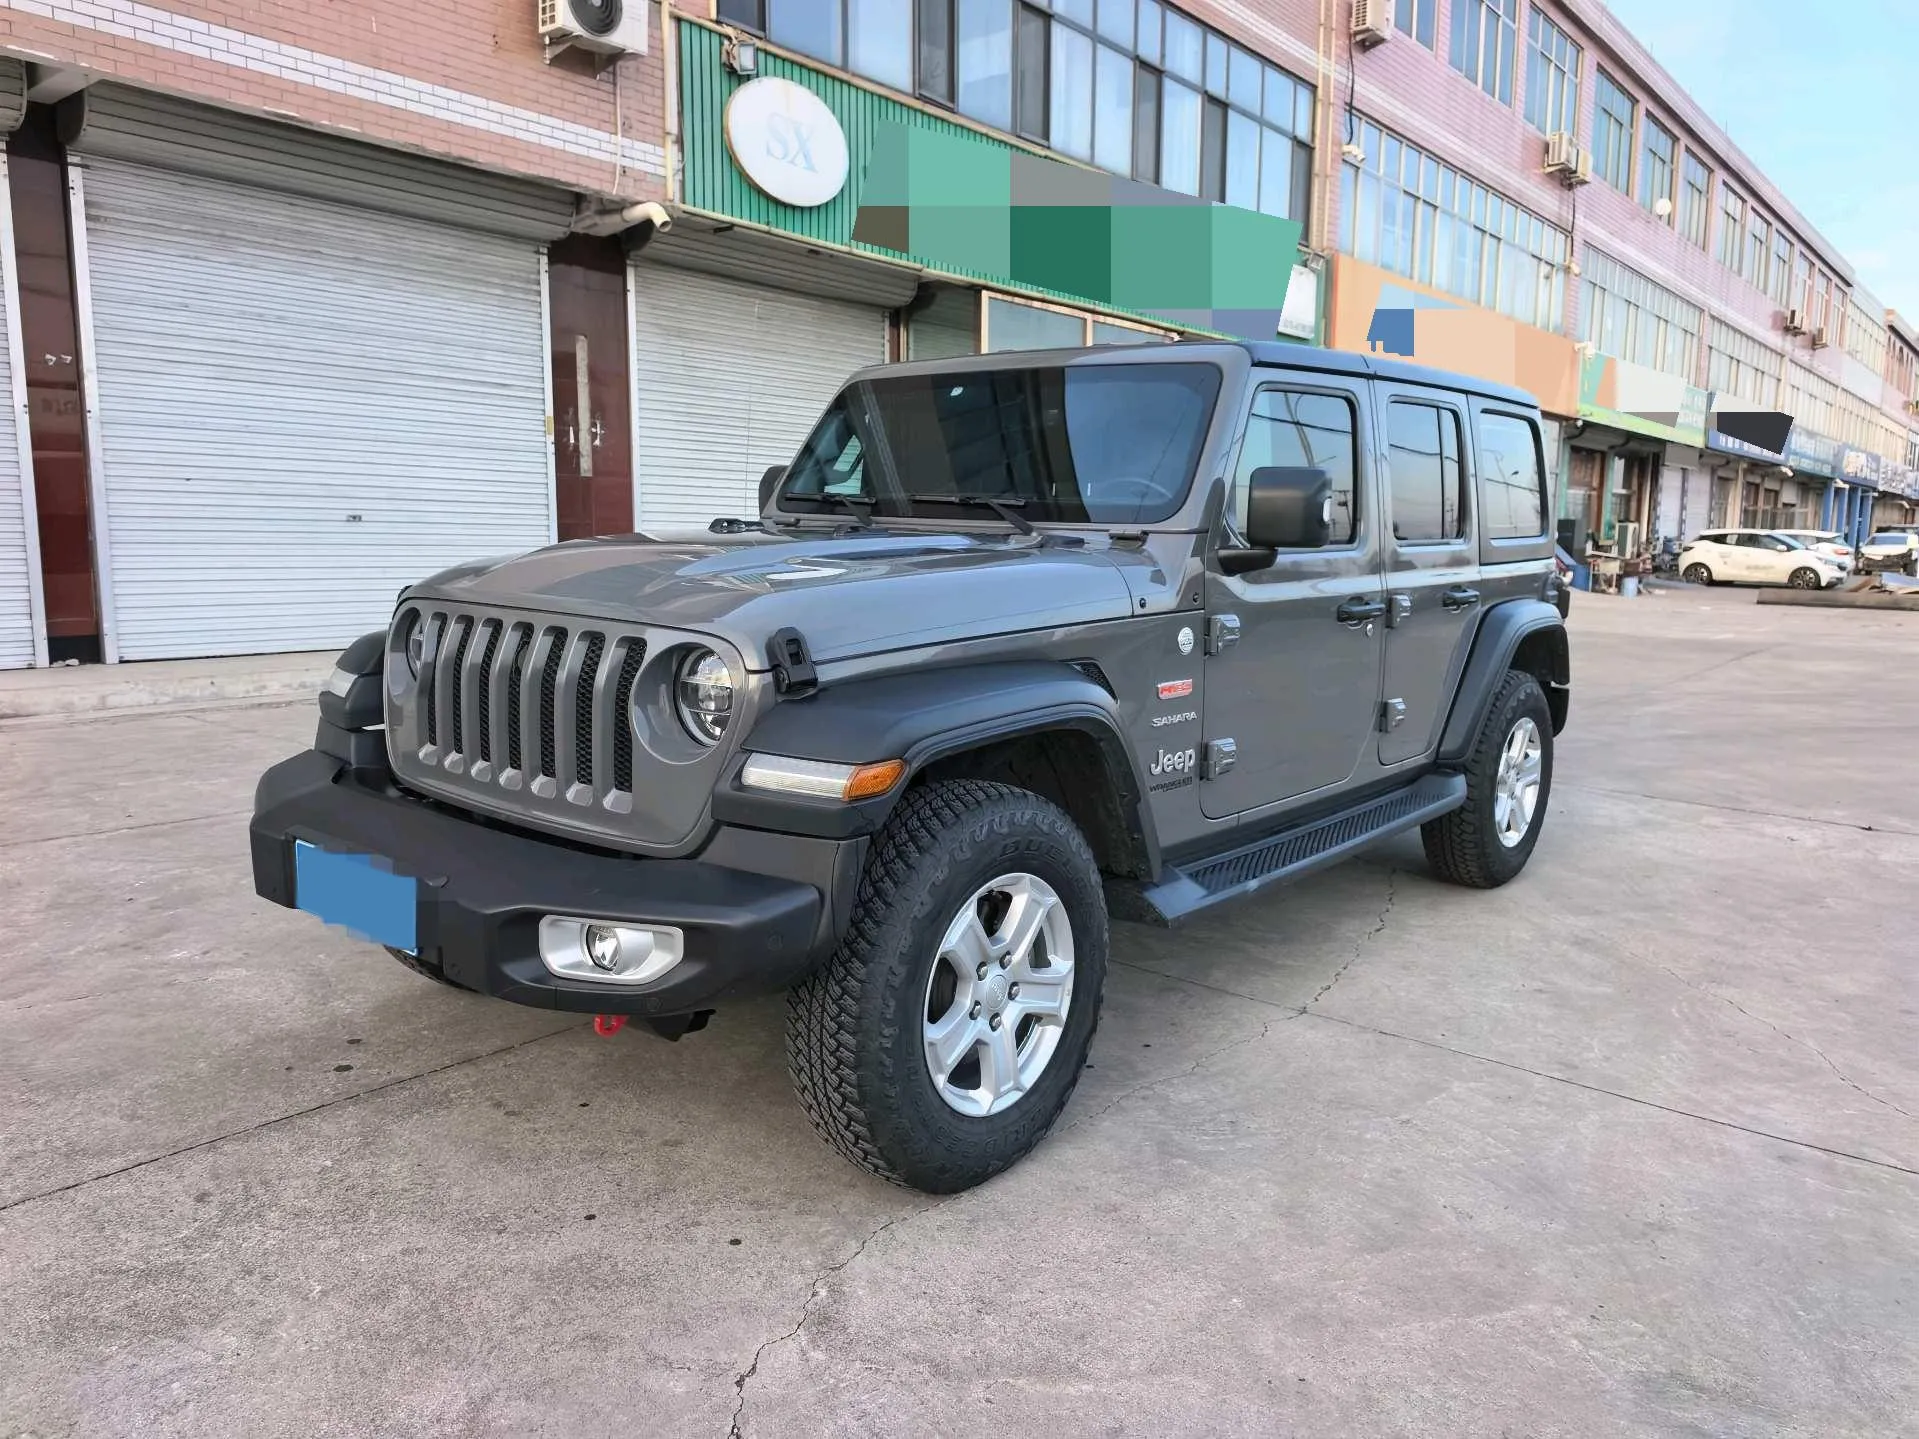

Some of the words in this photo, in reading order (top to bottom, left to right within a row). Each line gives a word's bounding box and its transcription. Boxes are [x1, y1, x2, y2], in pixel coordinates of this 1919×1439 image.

[765, 112, 818, 173] SX
[1152, 711, 1198, 727] SAHARA
[1150, 748, 1196, 775] Jeep
